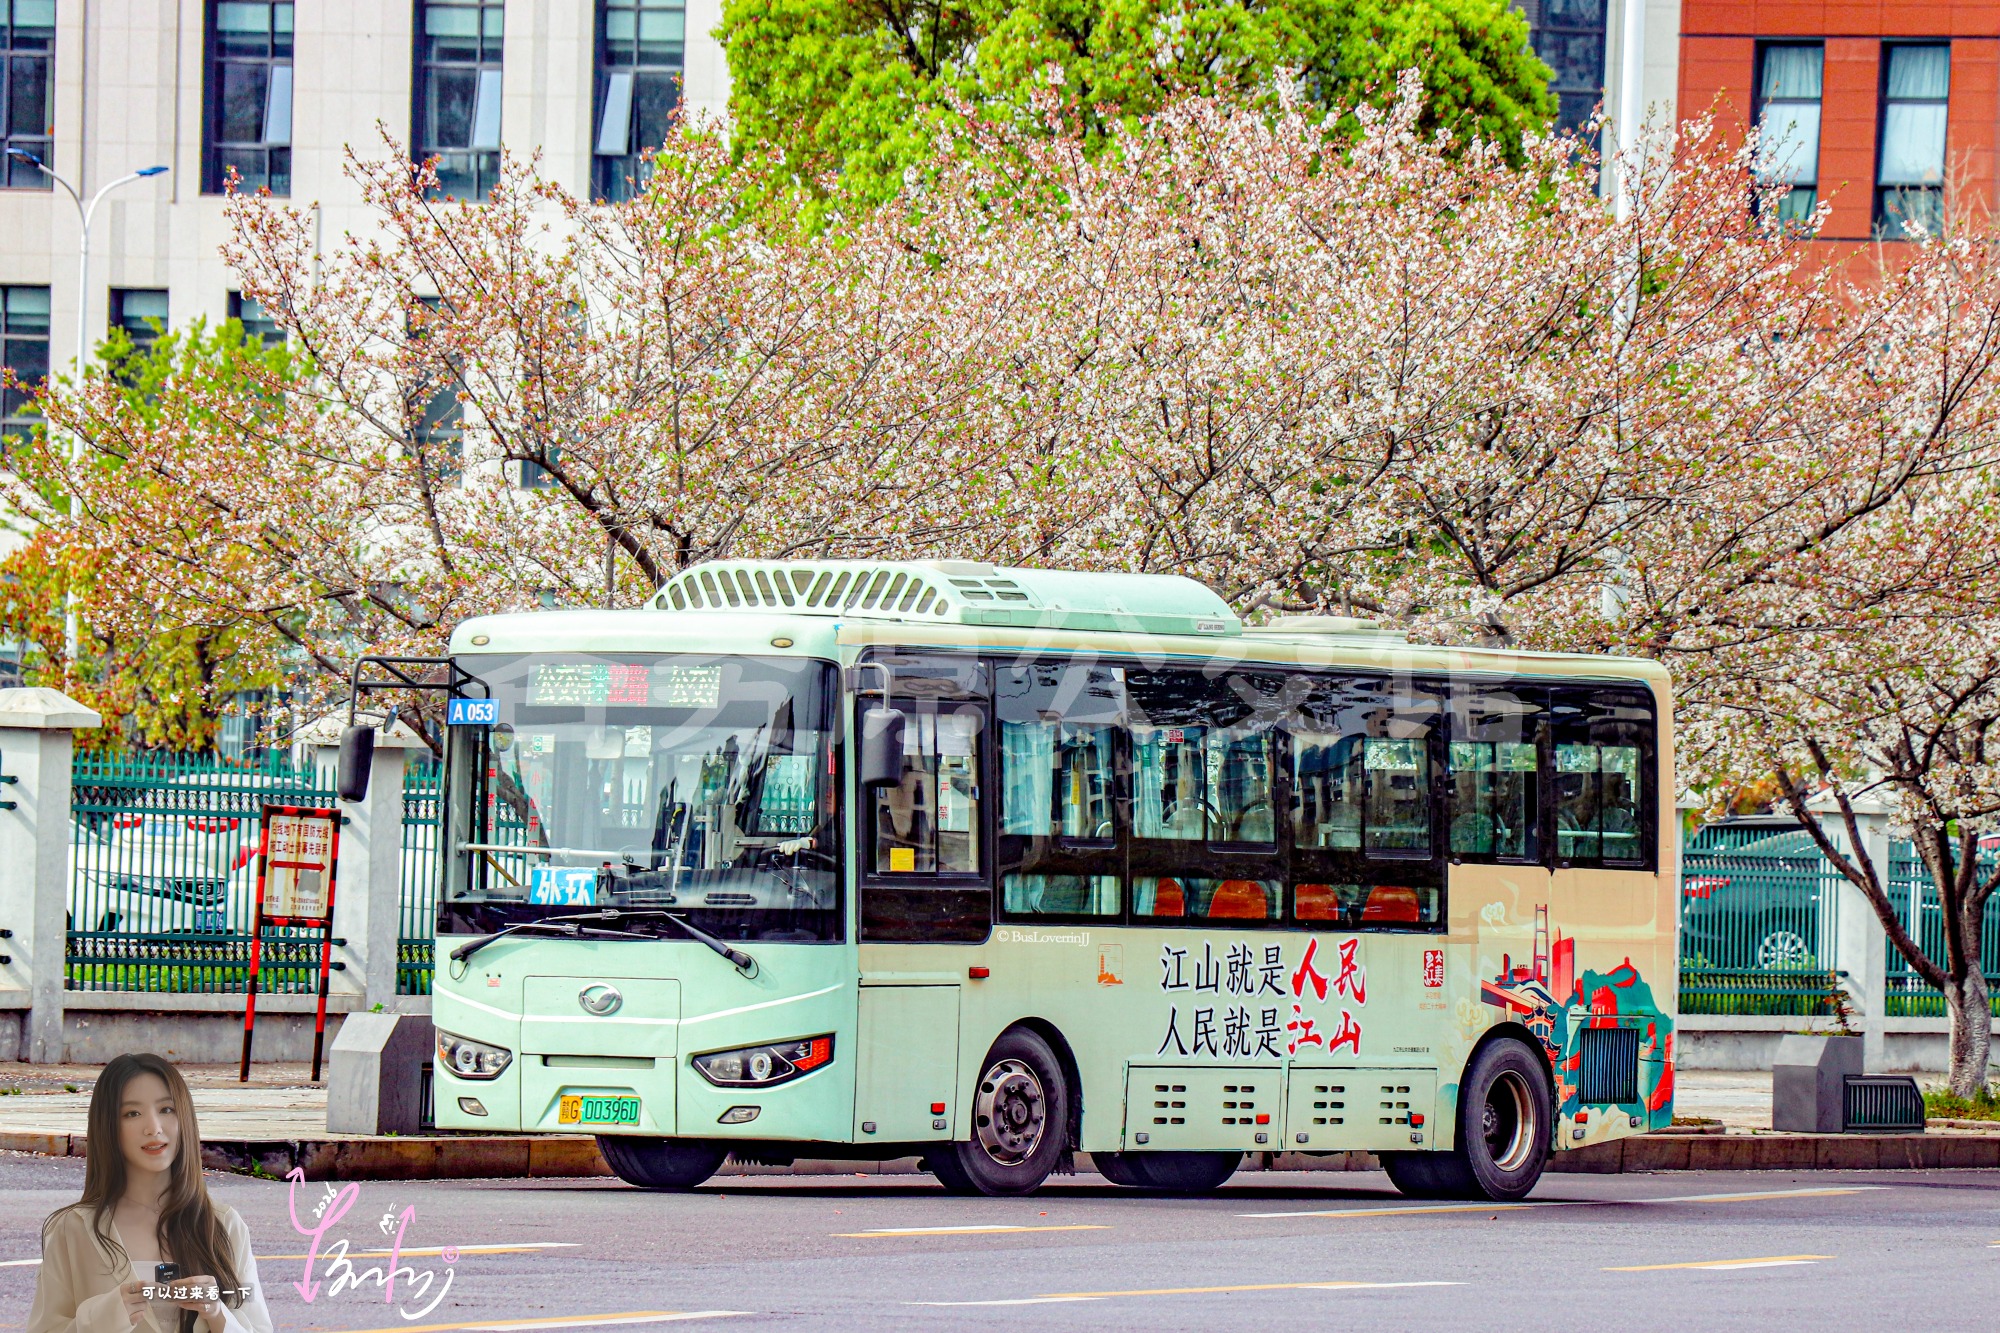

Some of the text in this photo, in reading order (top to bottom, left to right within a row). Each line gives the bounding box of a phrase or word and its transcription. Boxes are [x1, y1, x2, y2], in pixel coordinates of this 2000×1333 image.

[453, 703, 494, 721] A 053
[536, 870, 591, 906] 外环
[1161, 936, 1367, 1004] 江山就是人民
[1157, 1004, 1363, 1058] 人民就是江山
